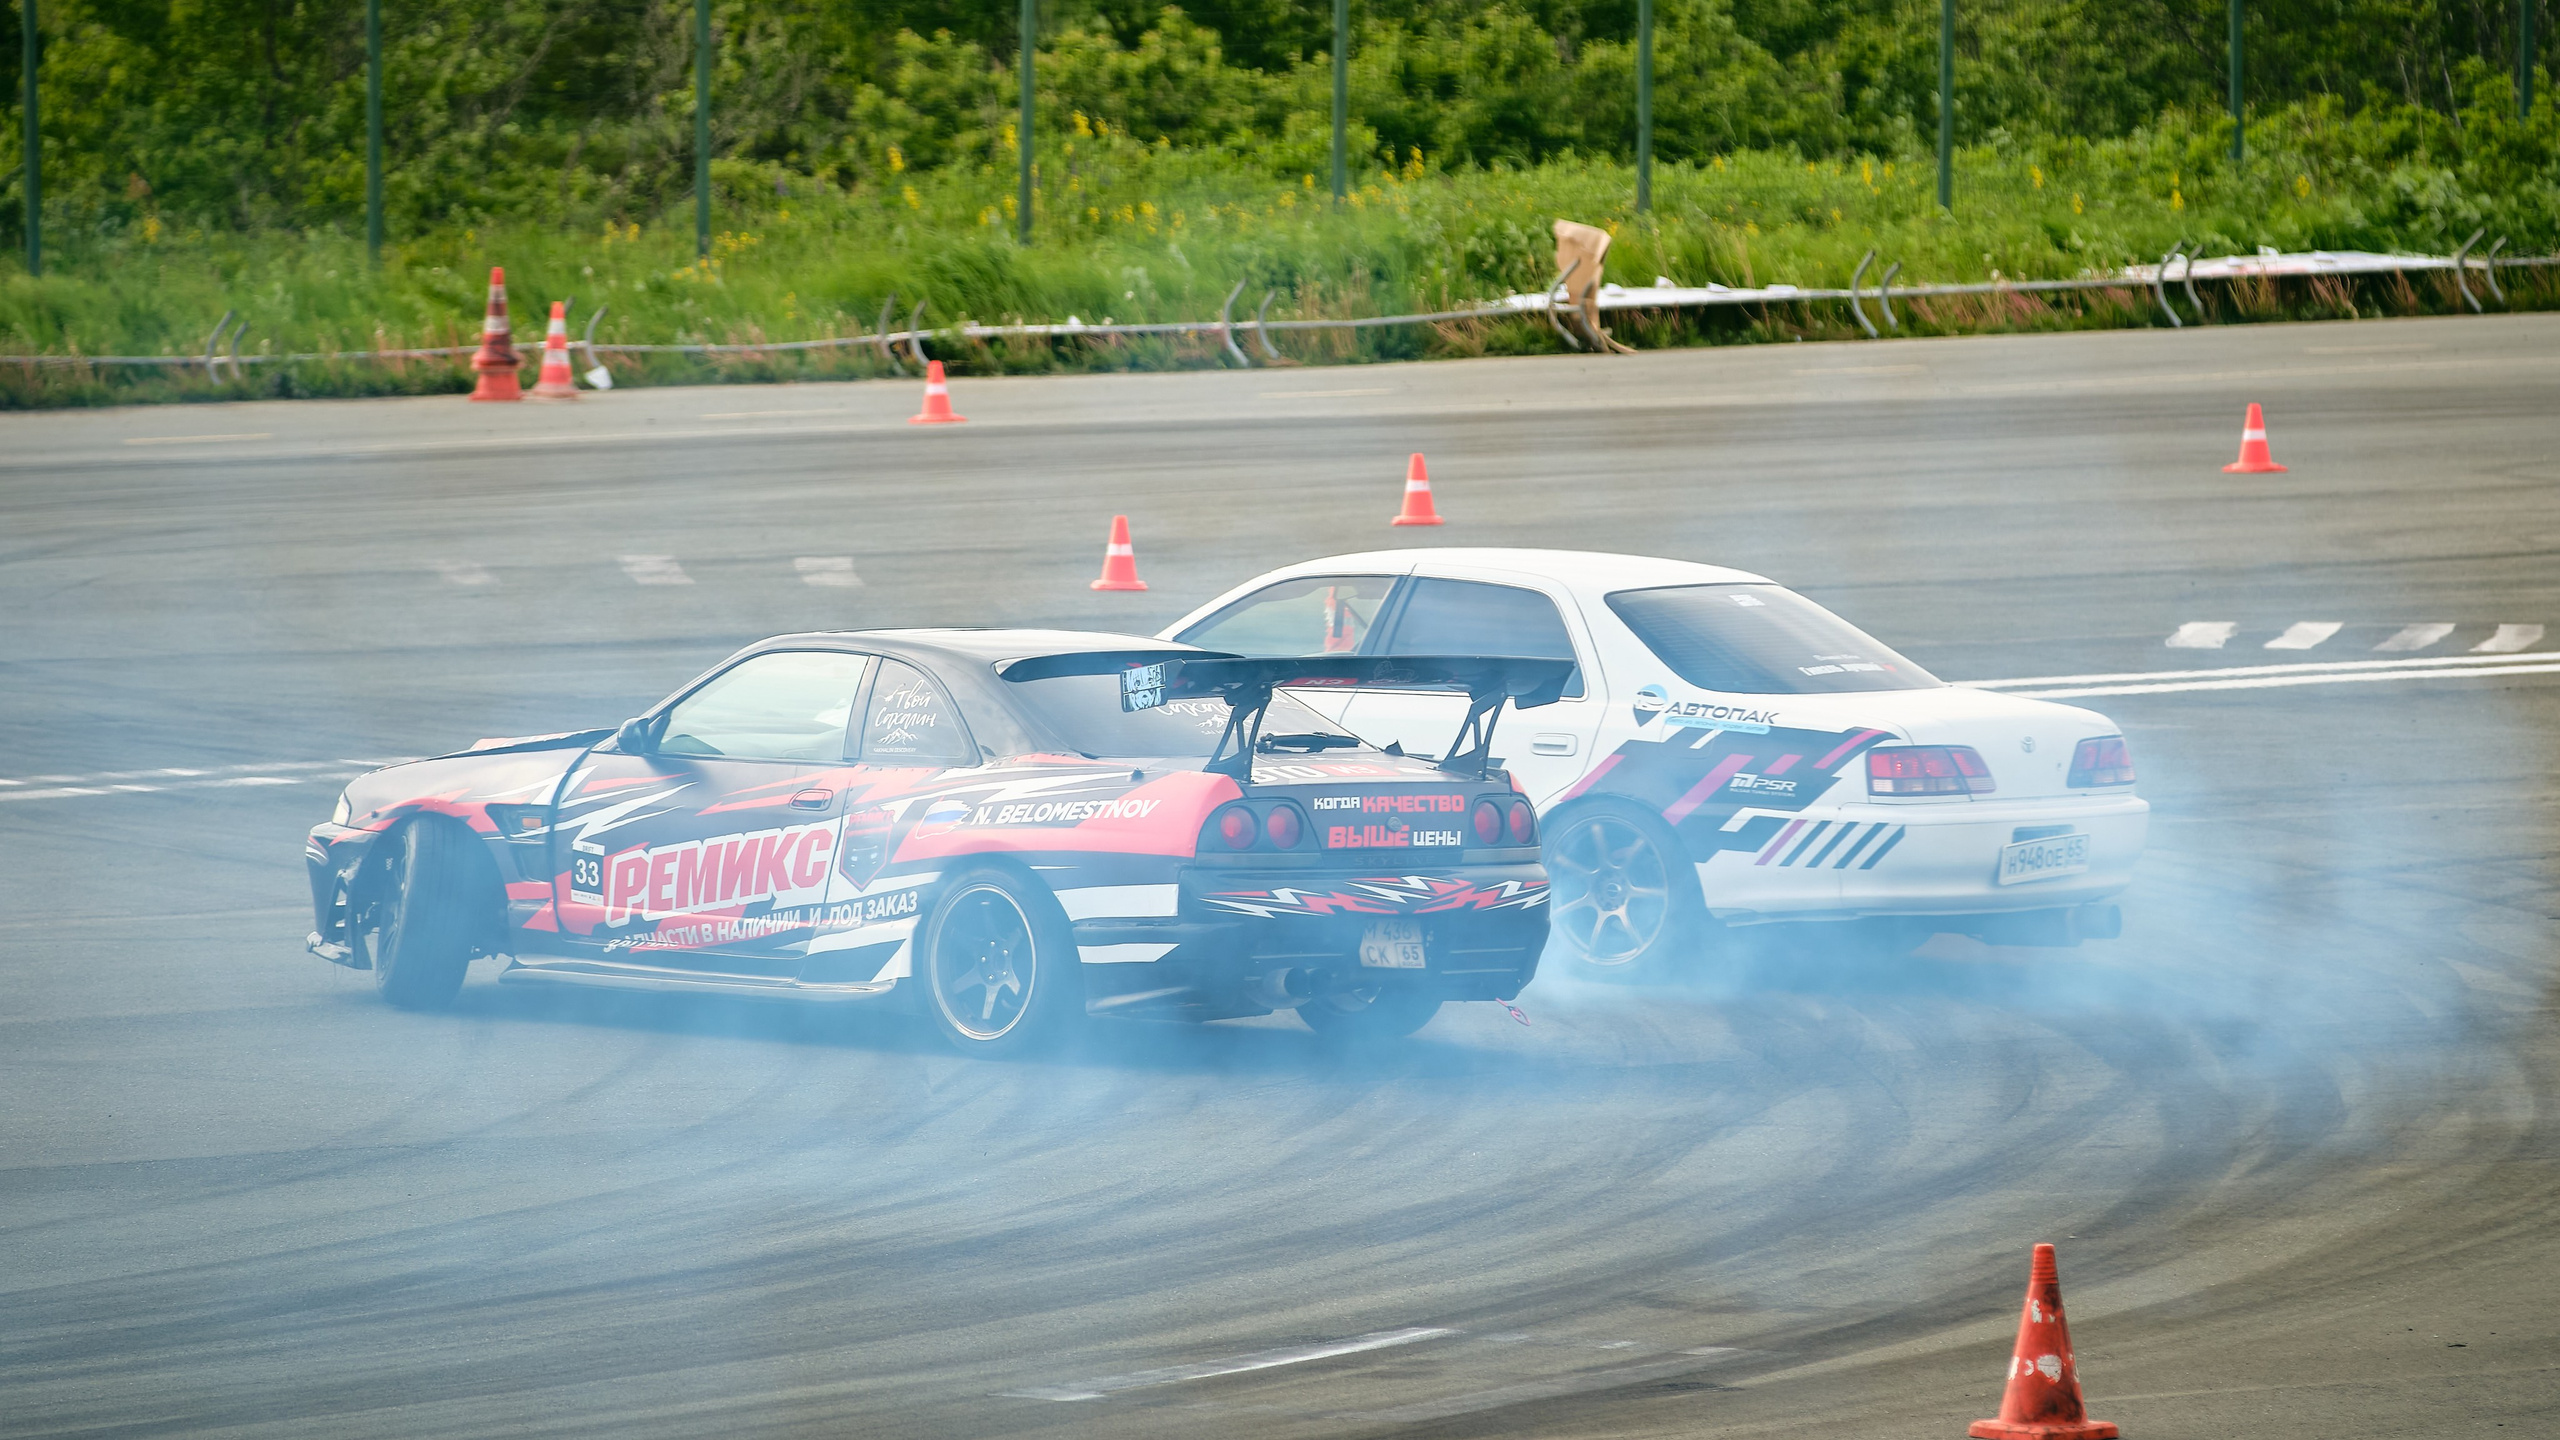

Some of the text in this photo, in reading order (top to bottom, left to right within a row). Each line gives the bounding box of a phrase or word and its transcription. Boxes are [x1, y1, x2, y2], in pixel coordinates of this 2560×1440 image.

[896, 680, 932, 709] Твой
[875, 706, 937, 730] Сахалин
[1665, 702, 1780, 724] АВТОПАК
[1752, 778, 1798, 792] PSR
[995, 799, 1162, 825] BELOMESTNOV
[1313, 794, 1465, 813] КОГДА КАЧЕСТВО
[1328, 824, 1462, 849] ВЫШЕ ЦЕНЫ
[575, 858, 600, 887] 33
[1353, 855, 1437, 867] SKYLINE
[608, 826, 836, 927] РЕМИКС
[701, 923, 714, 943] В
[717, 909, 801, 942] НАЛИЧИИ
[808, 907, 822, 927] И
[865, 890, 918, 920] ЗАКАЗ
[1402, 945, 1419, 961] 65
